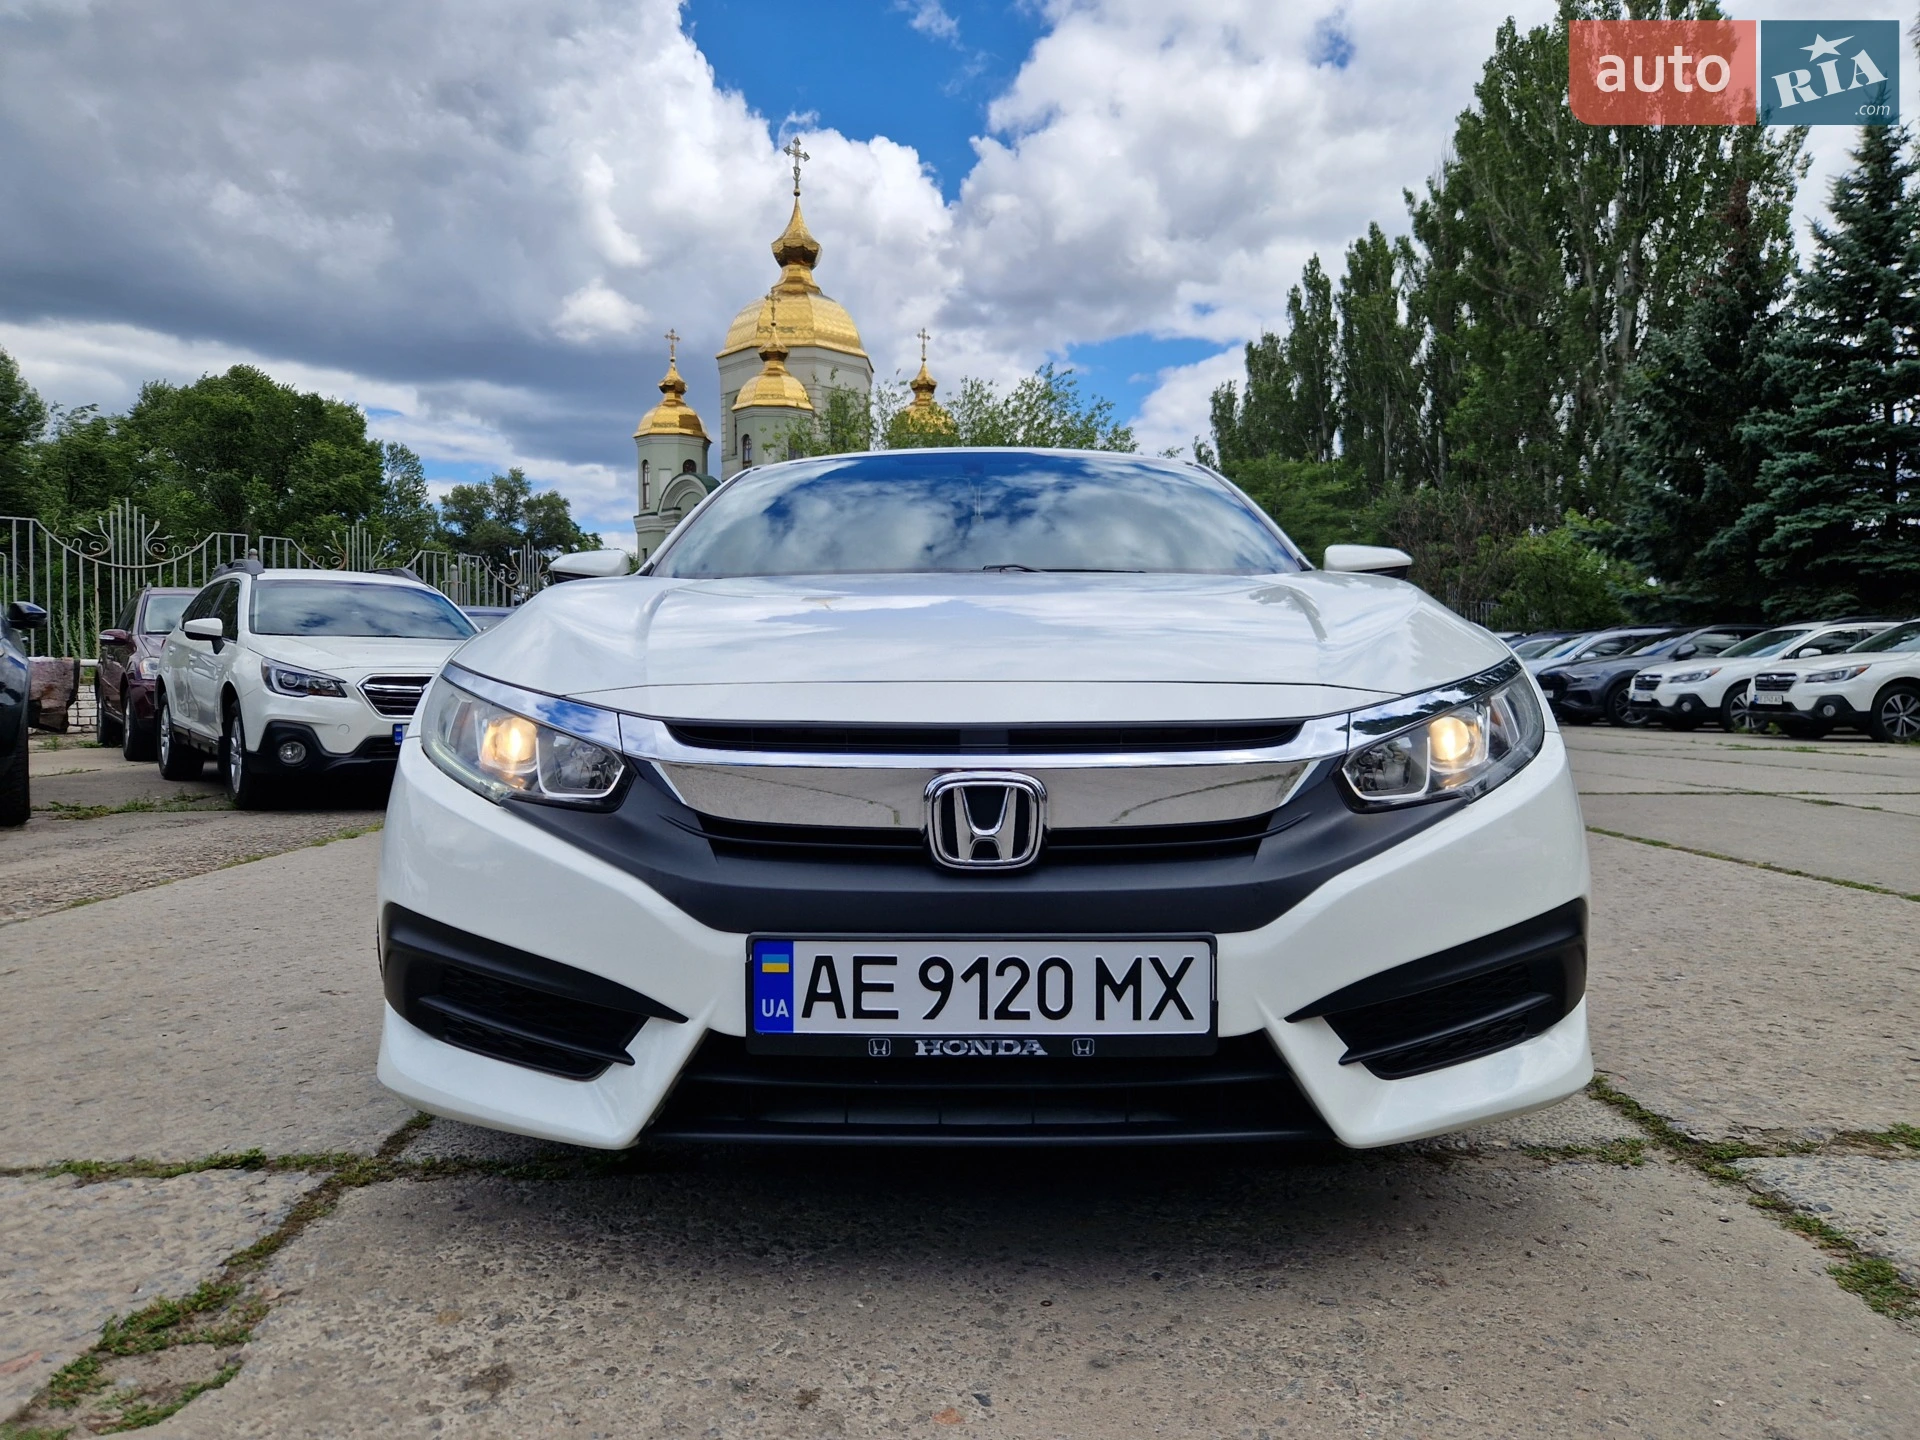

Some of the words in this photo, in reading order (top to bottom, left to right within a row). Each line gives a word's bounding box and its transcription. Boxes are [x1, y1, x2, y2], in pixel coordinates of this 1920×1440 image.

[801, 955, 899, 1020] AE
[918, 956, 1074, 1020] 9120
[1095, 956, 1195, 1021] MX
[761, 998, 789, 1018] UA
[914, 1039, 1048, 1056] HONDA
